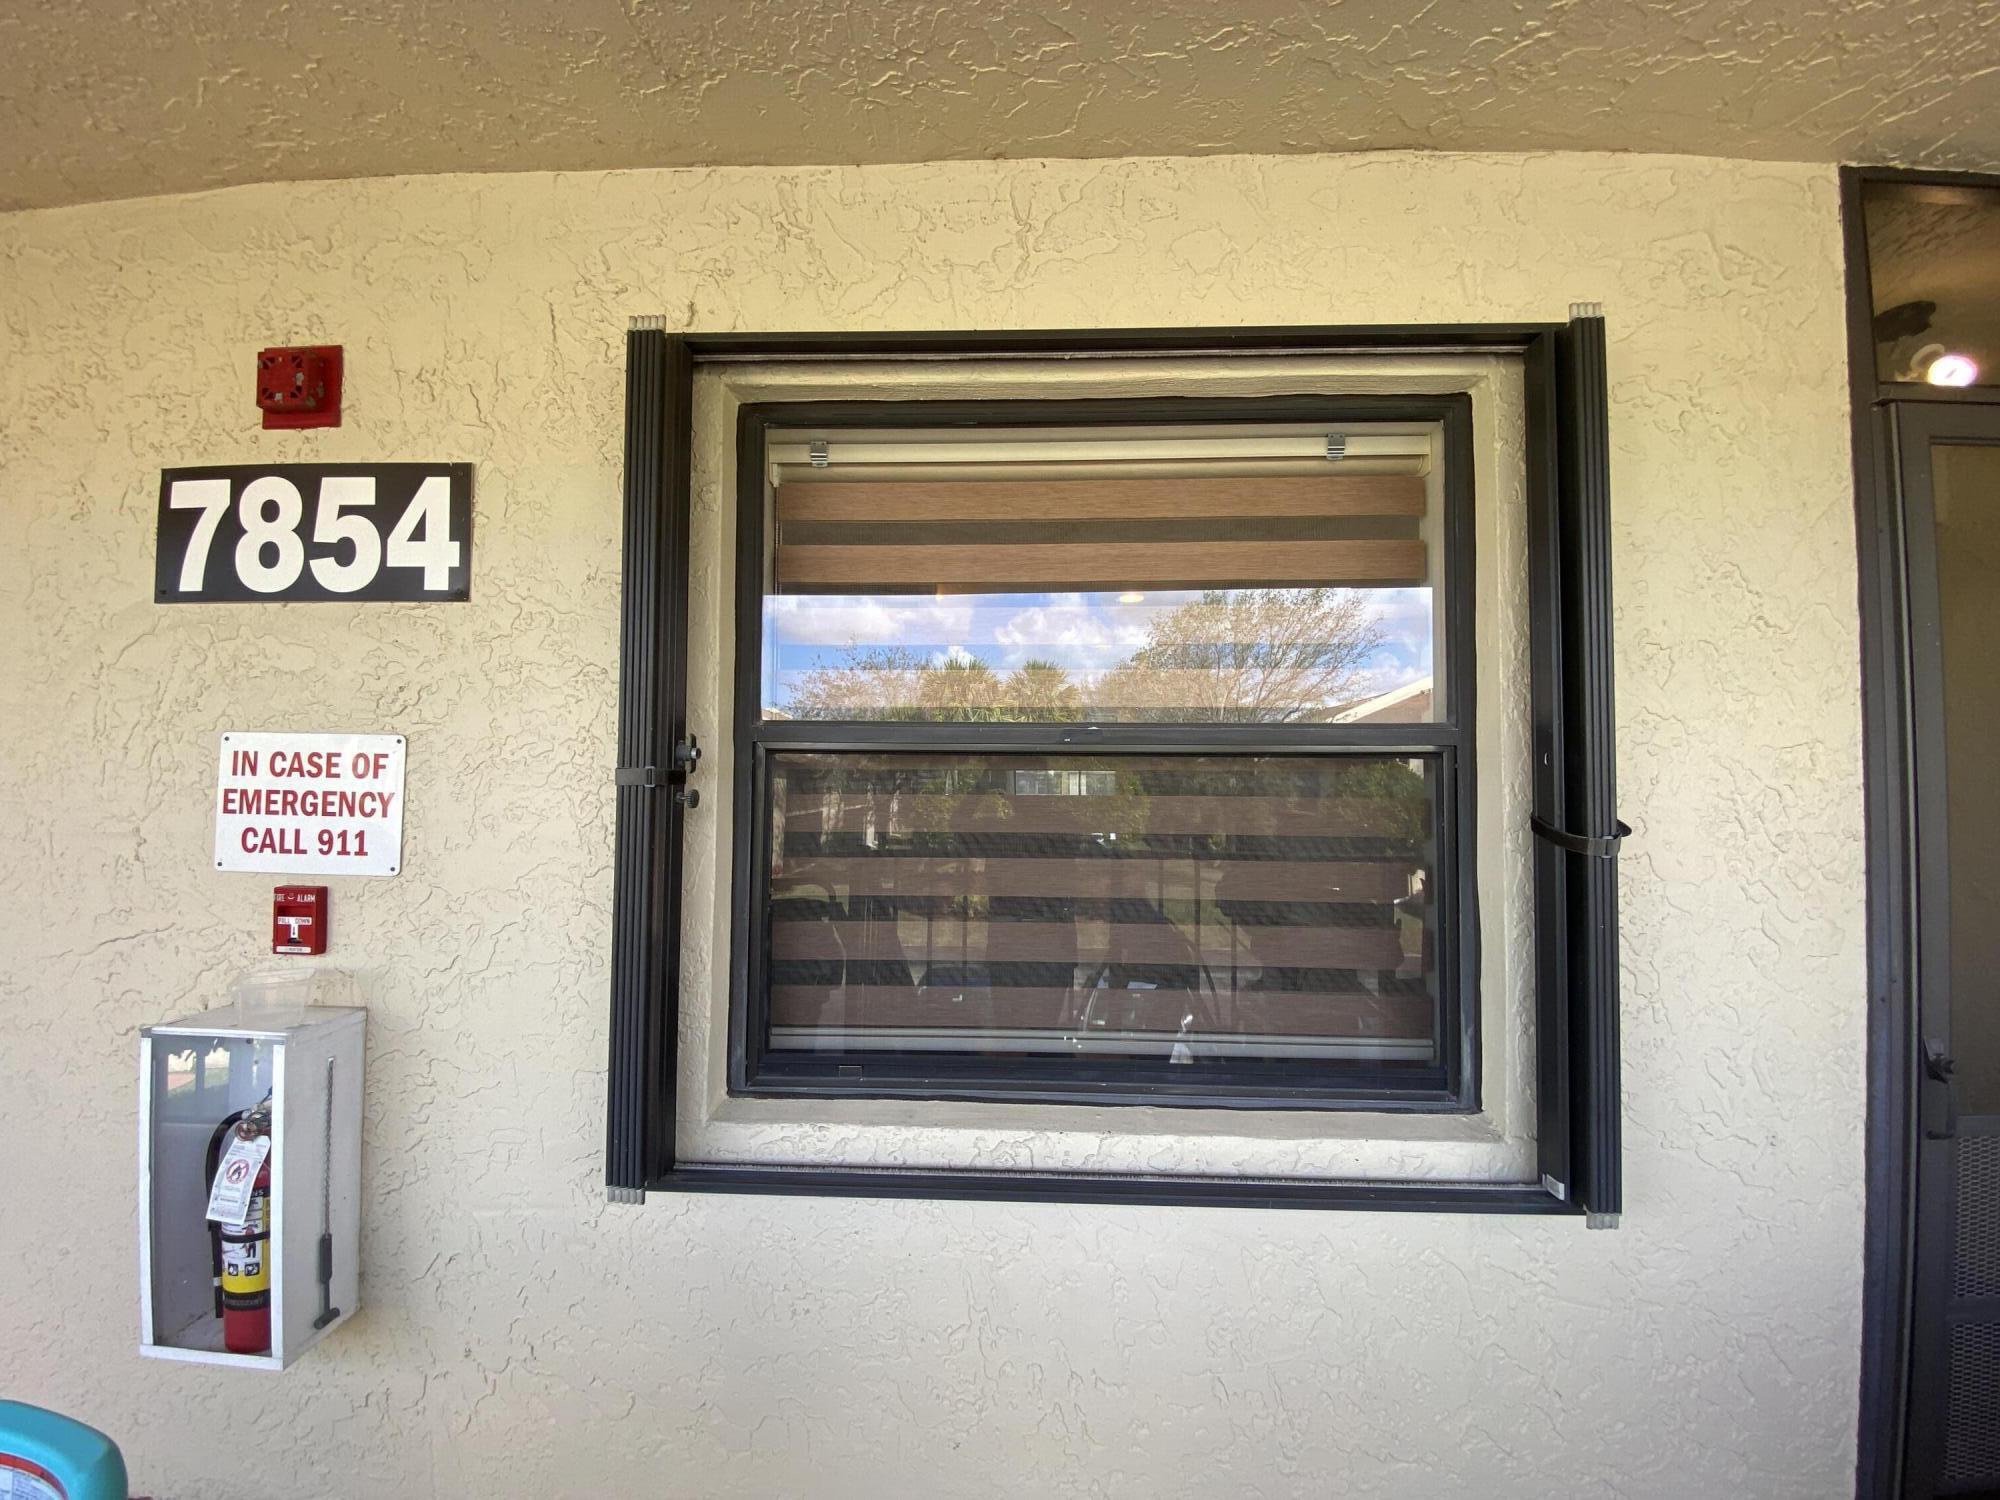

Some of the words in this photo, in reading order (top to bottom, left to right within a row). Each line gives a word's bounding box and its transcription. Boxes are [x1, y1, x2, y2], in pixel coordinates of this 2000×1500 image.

[169, 476, 460, 593] 7854
[231, 750, 259, 777] IN
[269, 751, 341, 779] CASE
[352, 752, 389, 779] OF
[222, 788, 395, 818] EMERGENCY
[241, 827, 308, 855] CALL
[317, 829, 368, 856] 911
[296, 894, 316, 902] ALARM
